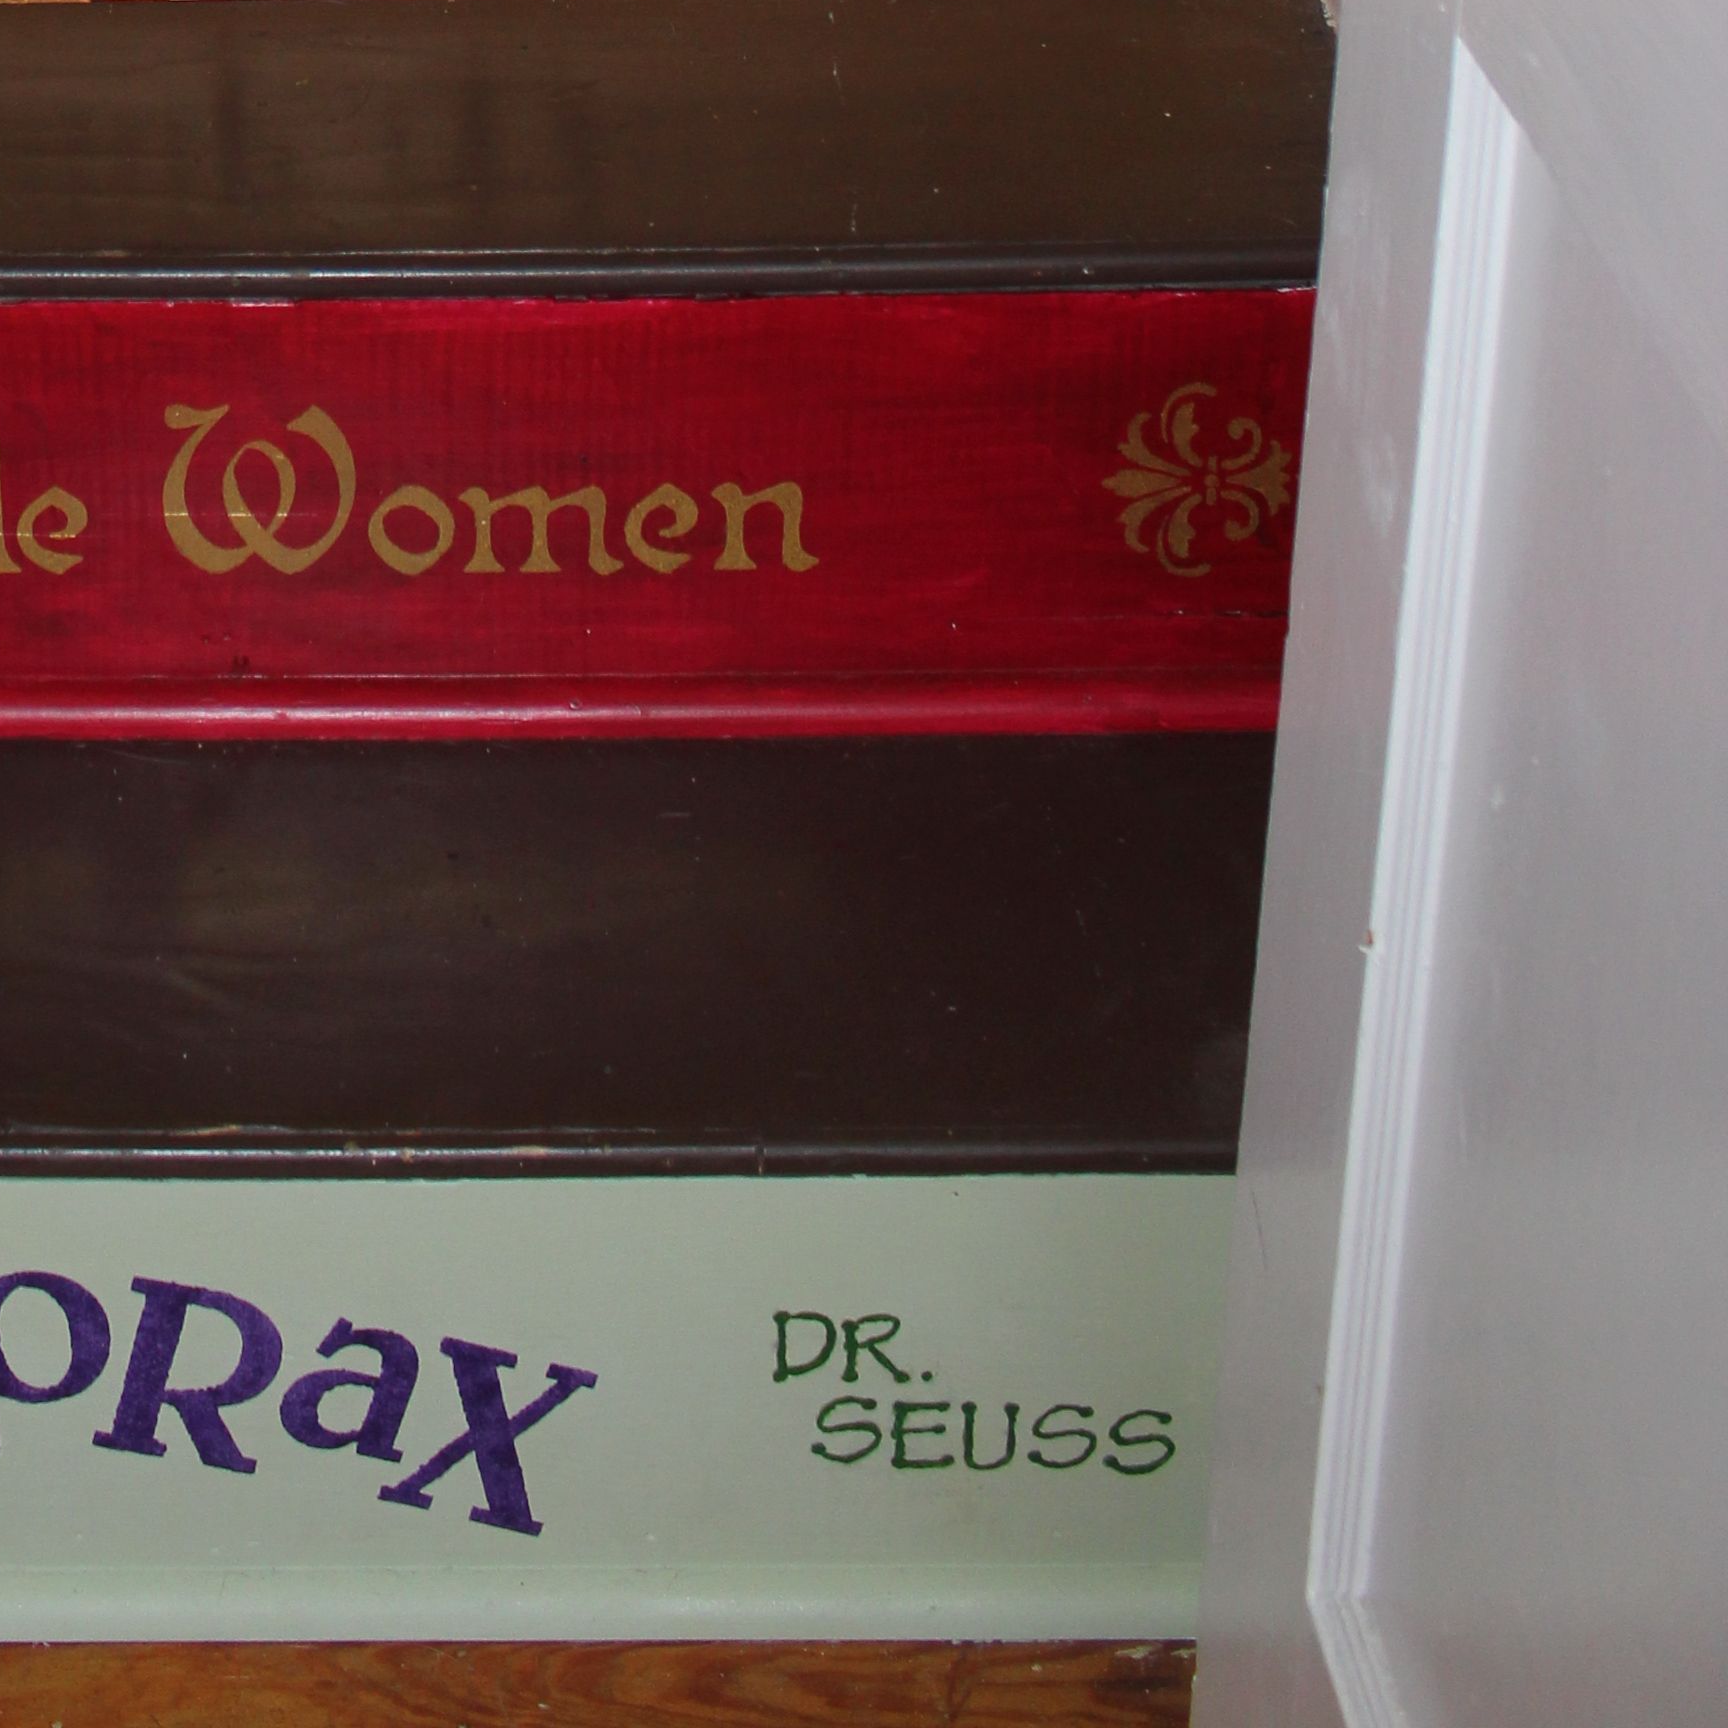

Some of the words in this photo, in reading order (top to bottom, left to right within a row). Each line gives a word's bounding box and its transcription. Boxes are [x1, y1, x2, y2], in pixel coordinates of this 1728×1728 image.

[161, 404, 819, 580] Women
[770, 1310, 935, 1385] DR.
[808, 1396, 1176, 1477] SEUSS
